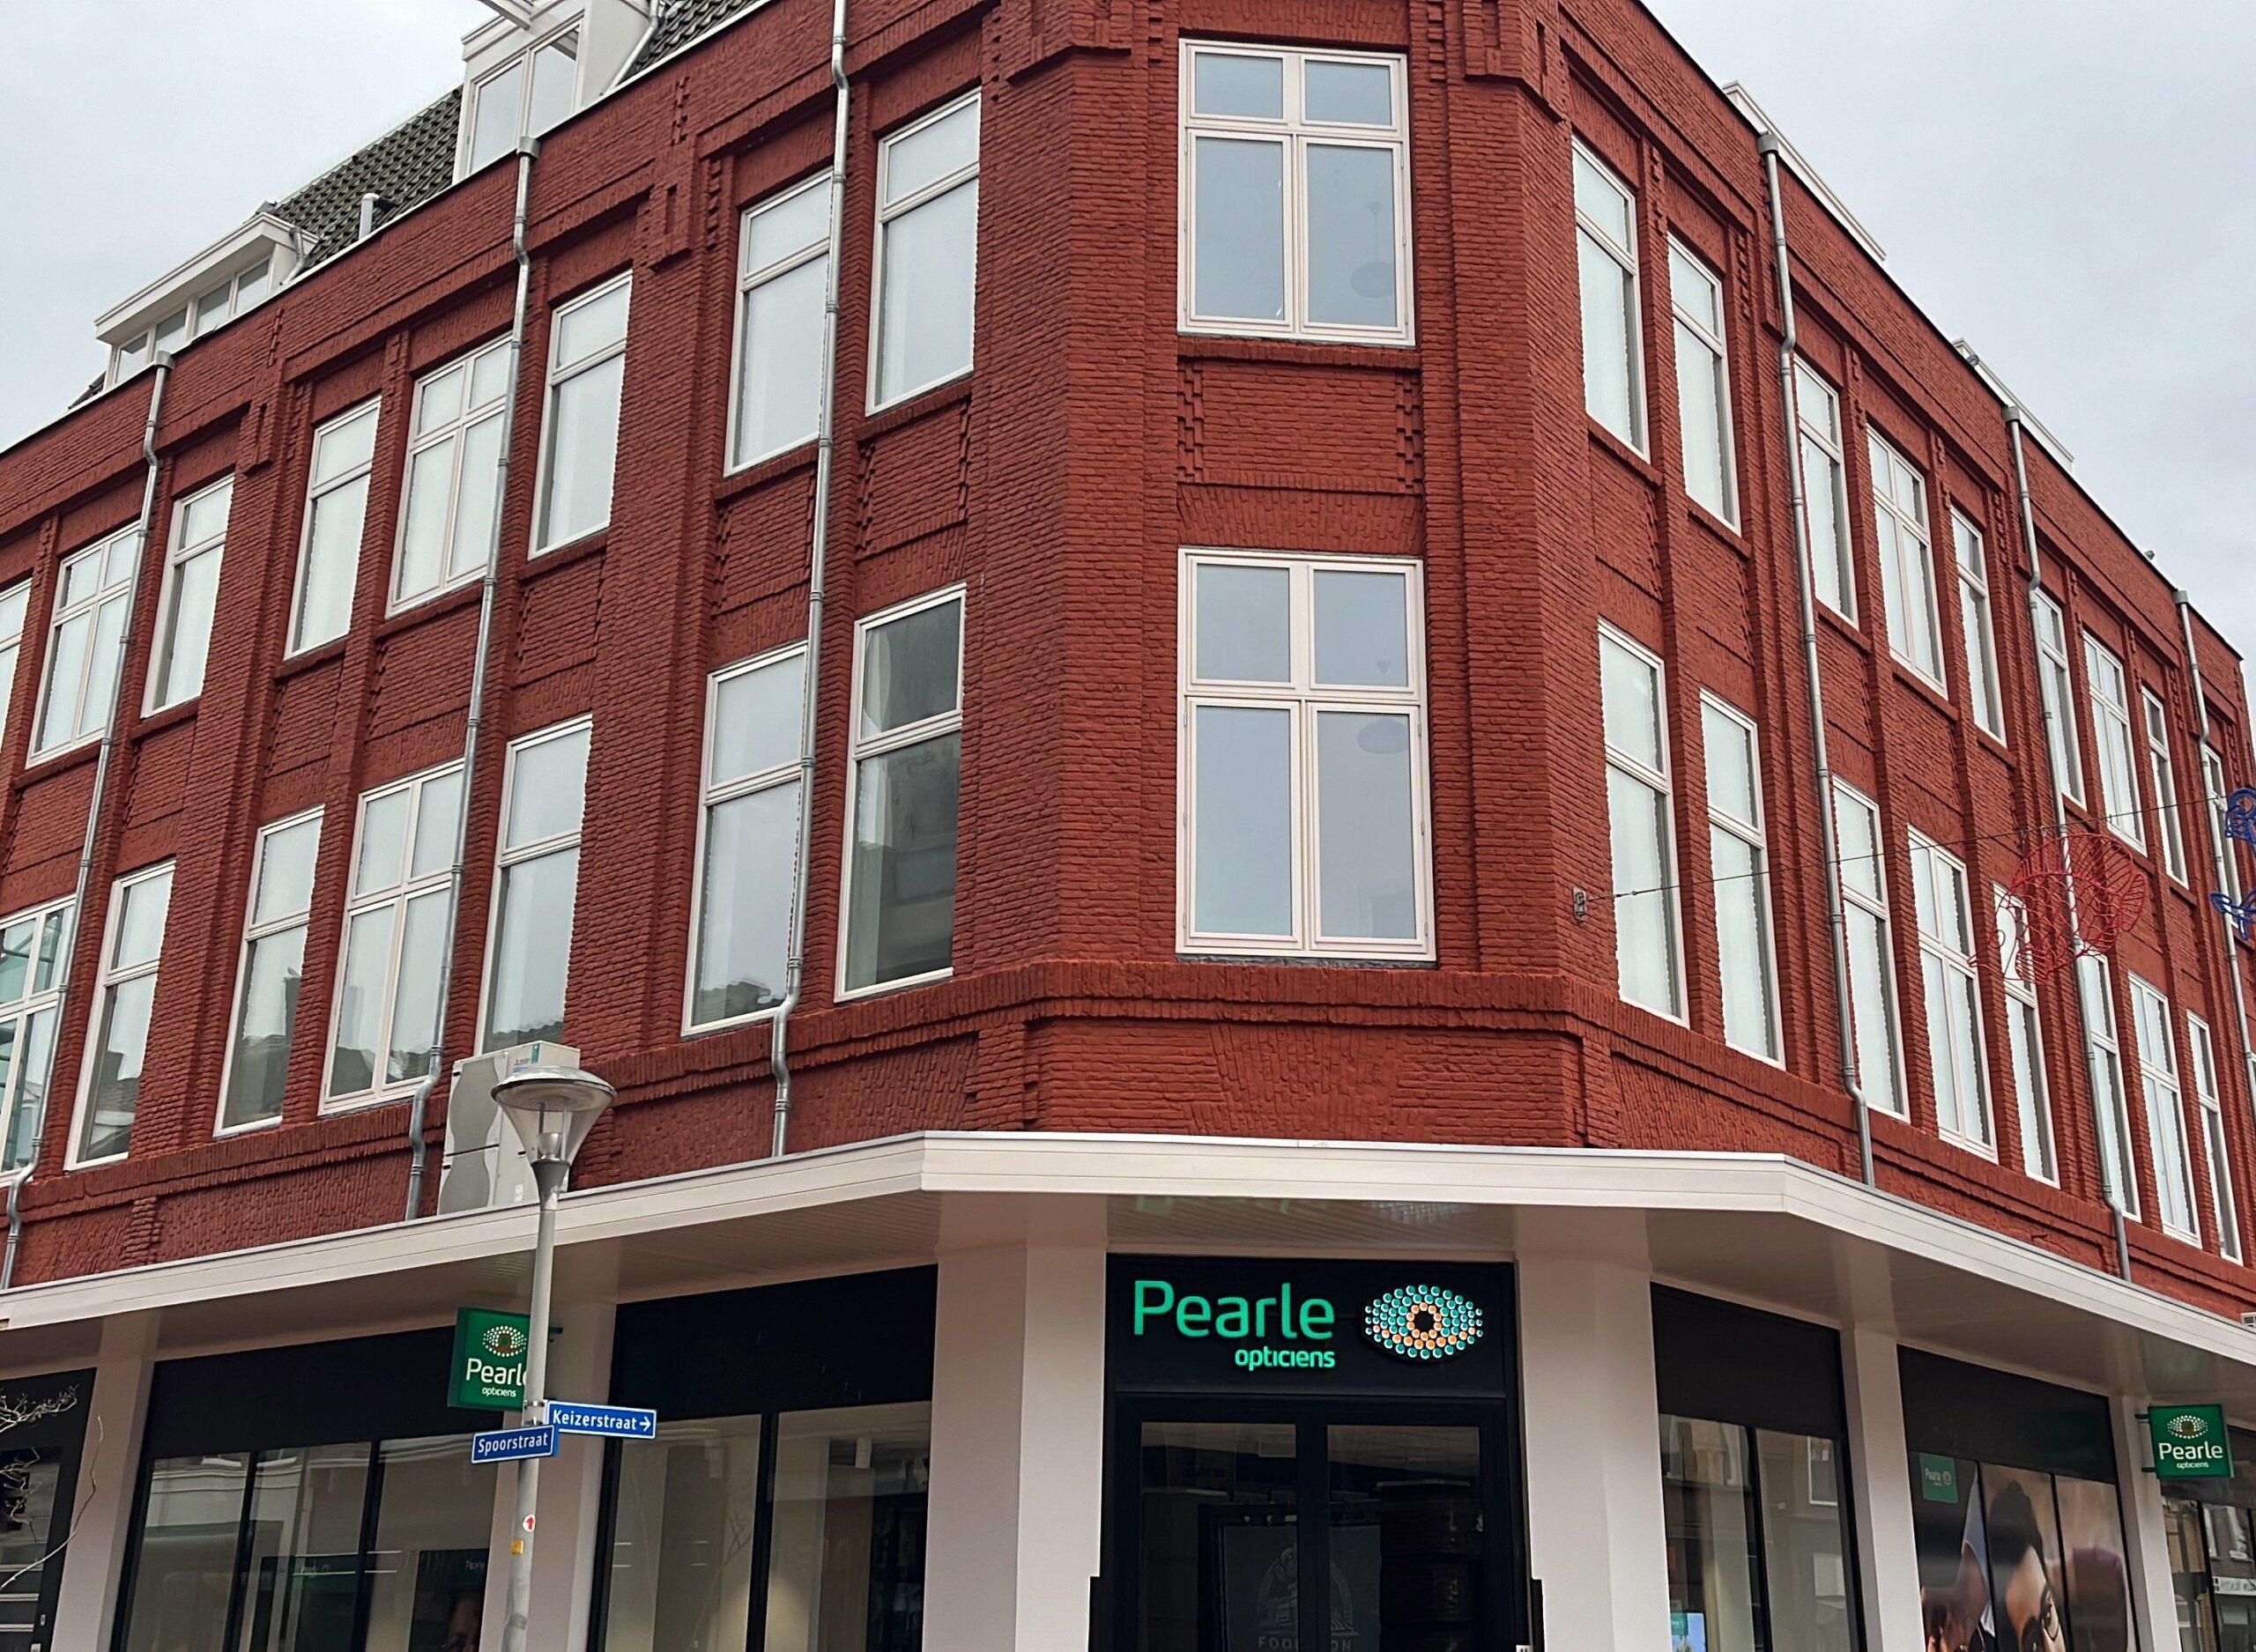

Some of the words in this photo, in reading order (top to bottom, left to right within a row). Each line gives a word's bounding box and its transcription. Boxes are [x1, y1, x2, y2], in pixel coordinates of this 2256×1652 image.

[1133, 1280, 1335, 1339] Pearle
[1235, 1345, 1336, 1372] opticiens
[481, 1386, 517, 1398] opticiens
[553, 1409, 638, 1432] Keizerstraat
[477, 1432, 549, 1457] Spoorstraat
[2157, 1441, 2223, 1461] Pearle
